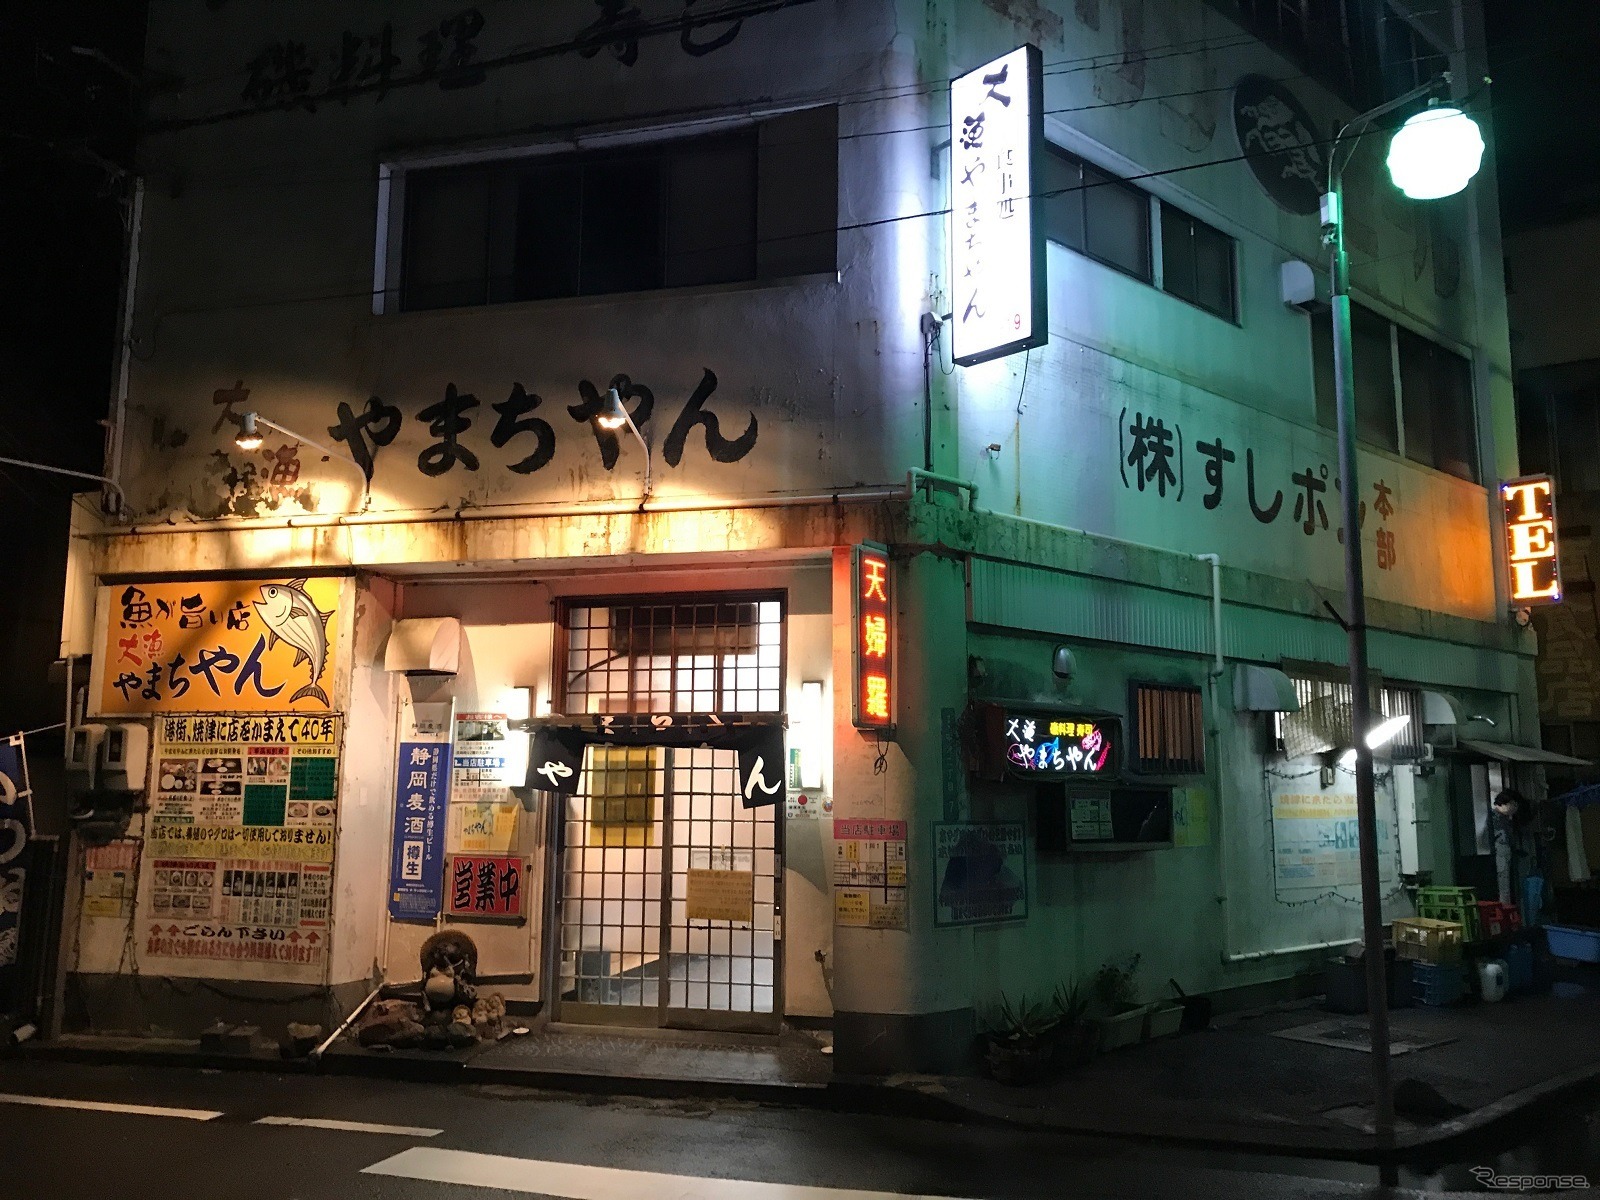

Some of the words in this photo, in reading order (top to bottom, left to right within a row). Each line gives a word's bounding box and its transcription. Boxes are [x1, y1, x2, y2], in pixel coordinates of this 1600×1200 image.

[1372, 478, 1396, 572] 本部
[1505, 481, 1558, 600] TEL
[119, 585, 251, 631] 魚が旨い店
[116, 629, 165, 667] 大漁
[863, 558, 889, 720] 天婦羅
[404, 747, 431, 834] 静岡麦酒
[840, 823, 901, 837] 当店駐車場
[405, 844, 421, 877] 樽生
[453, 860, 520, 912] 営業中
[182, 924, 286, 941] ごらん下さい
